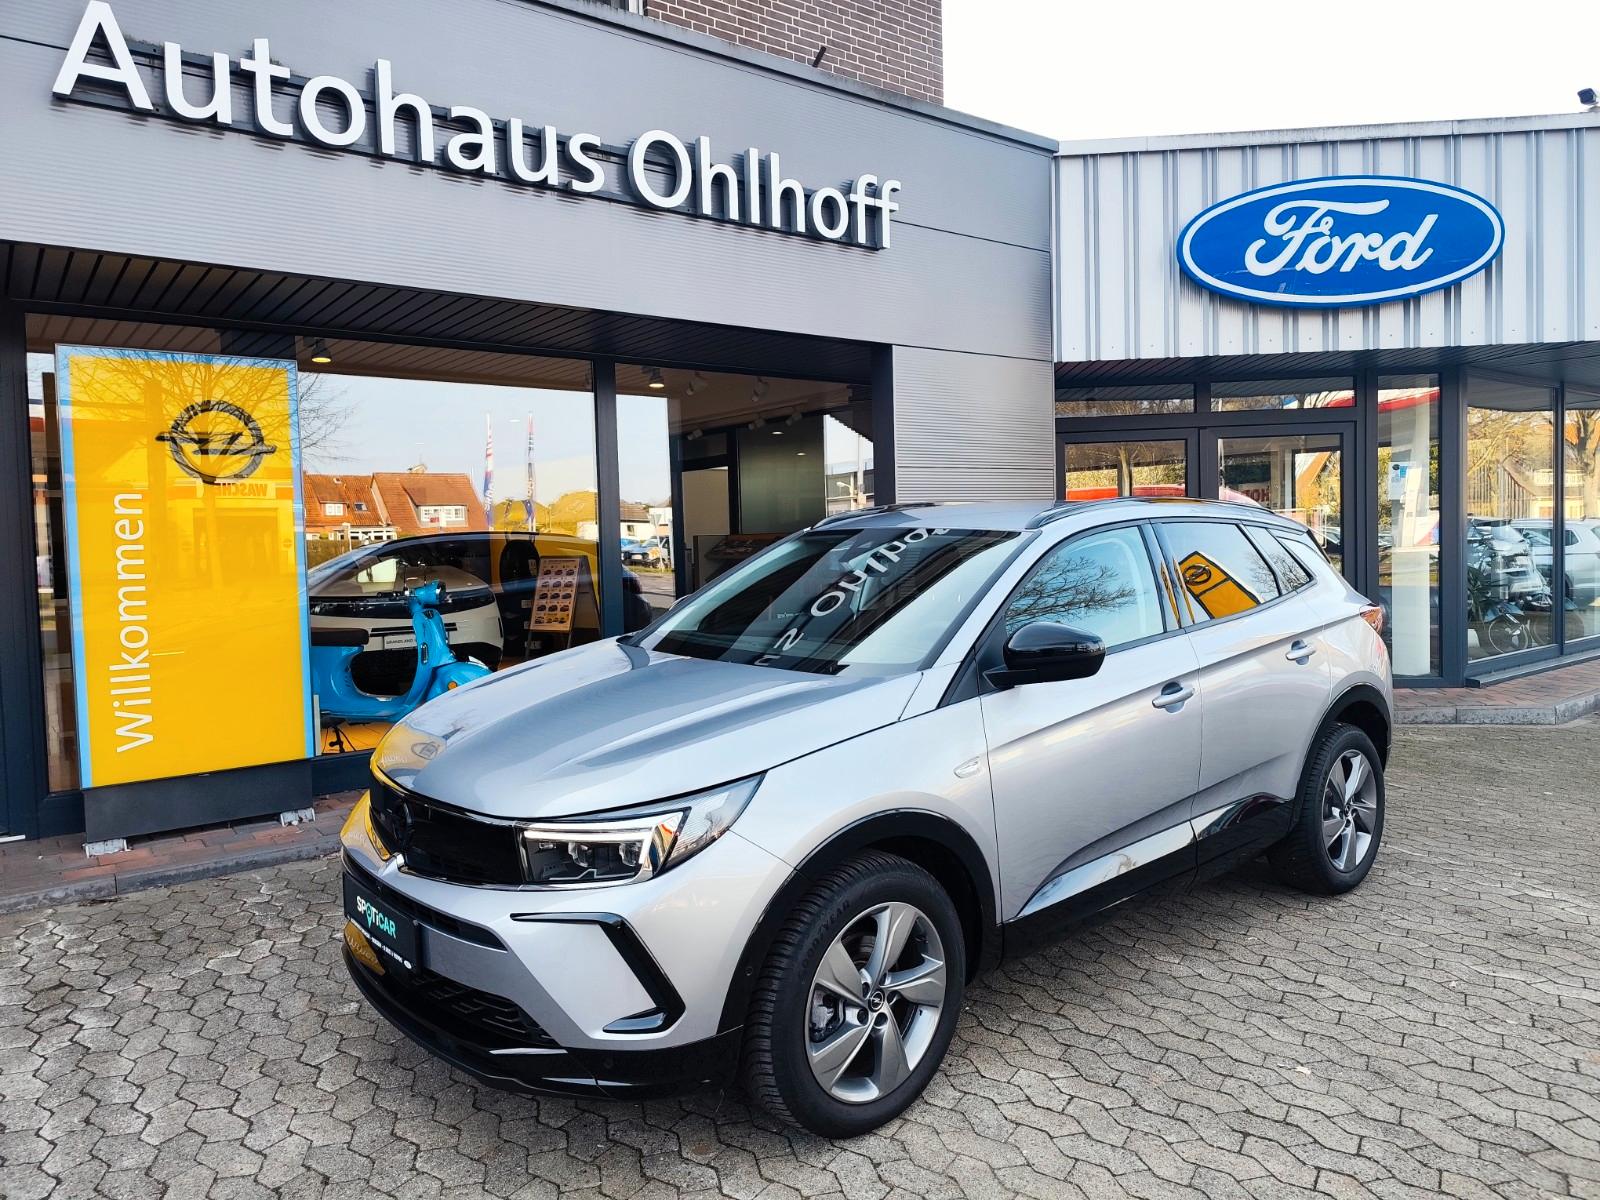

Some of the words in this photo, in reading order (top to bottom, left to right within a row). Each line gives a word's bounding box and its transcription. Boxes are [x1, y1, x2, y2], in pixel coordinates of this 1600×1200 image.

[52, 0, 605, 194] Autohaus
[628, 130, 902, 249] Ohlhoff
[1245, 199, 1438, 277] Ford
[110, 492, 155, 754] Willkommen
